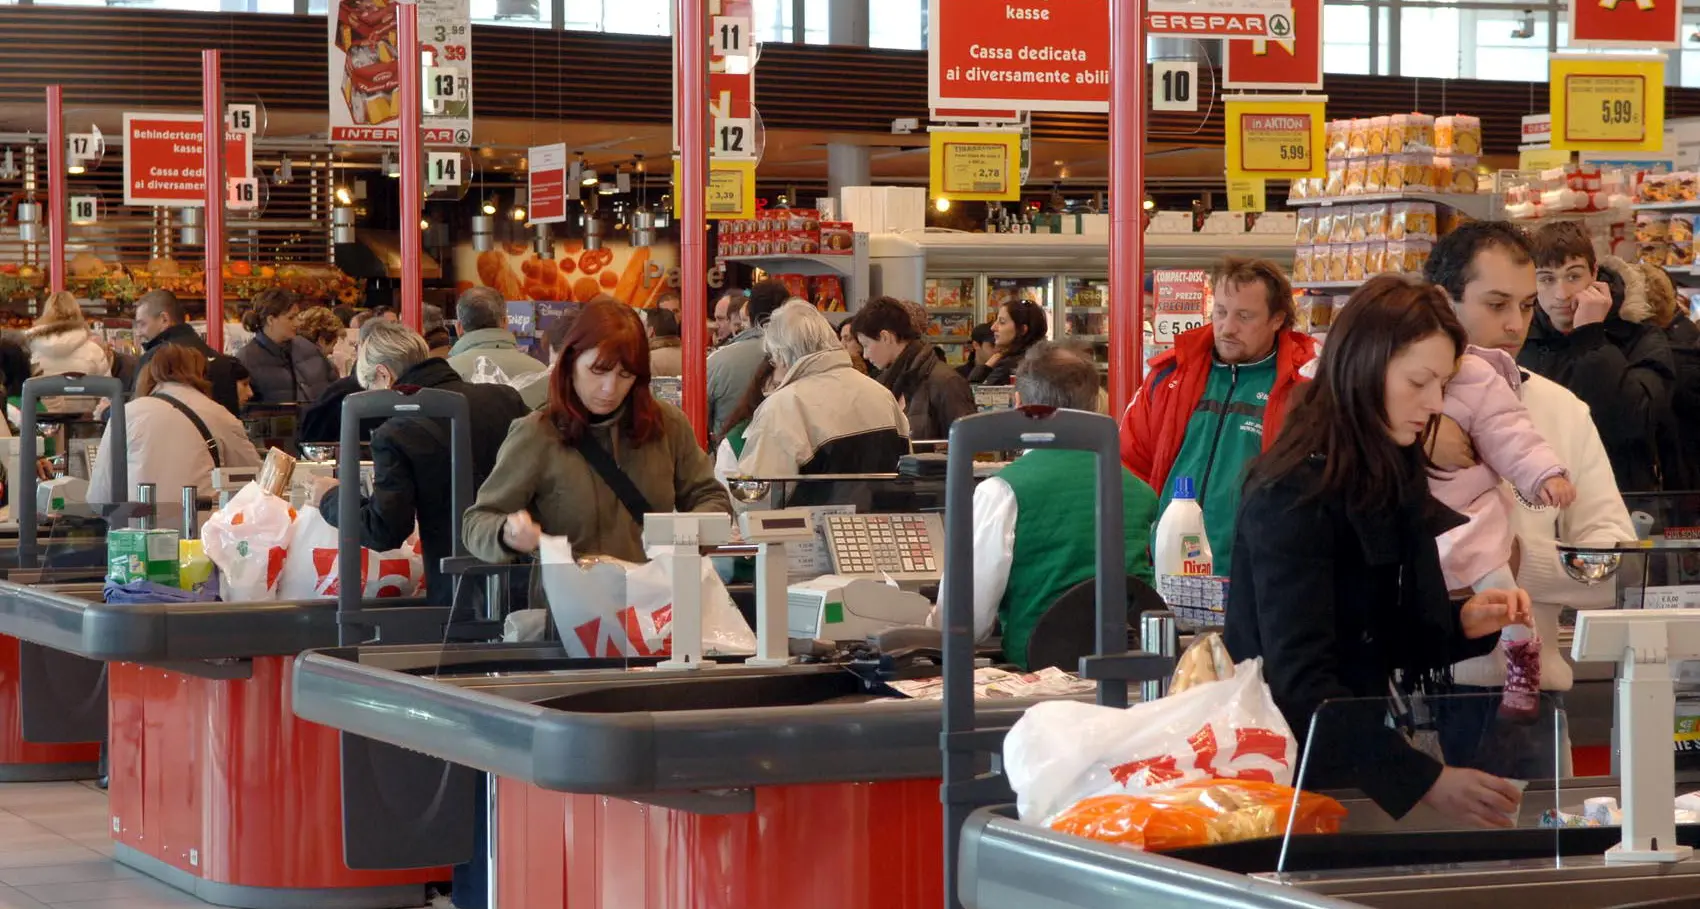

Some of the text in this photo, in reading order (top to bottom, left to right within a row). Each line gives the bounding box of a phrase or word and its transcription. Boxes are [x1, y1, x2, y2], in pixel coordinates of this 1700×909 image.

[1006, 5, 1050, 20] kasse
[1145, 15, 1264, 31] ERSPAR
[720, 24, 739, 49] 11
[969, 44, 1087, 62] Cassa dedicata
[946, 66, 1109, 84] ai diversamente abili
[434, 75, 454, 96] 13
[1162, 70, 1190, 102] 10
[232, 110, 251, 129] 15
[1602, 100, 1632, 124] 5,99
[1253, 118, 1303, 129] in AKTION
[133, 129, 242, 142] Behindertenghte
[340, 128, 450, 141] INTERAR
[720, 126, 744, 151] 12
[74, 138, 88, 154] 17
[173, 143, 203, 154] kasse
[1280, 145, 1304, 160] 5,99
[150, 166, 179, 177] Cassa
[436, 159, 455, 180] 14
[979, 168, 1000, 178] 2,78
[135, 180, 206, 191] ai diversamen
[235, 184, 253, 201] 16
[714, 192, 734, 200] 3,39
[76, 202, 92, 217] 18
[643, 259, 724, 289] Pae
[1156, 271, 1204, 283] COMPACT-DISC
[1158, 320, 1168, 335] €
